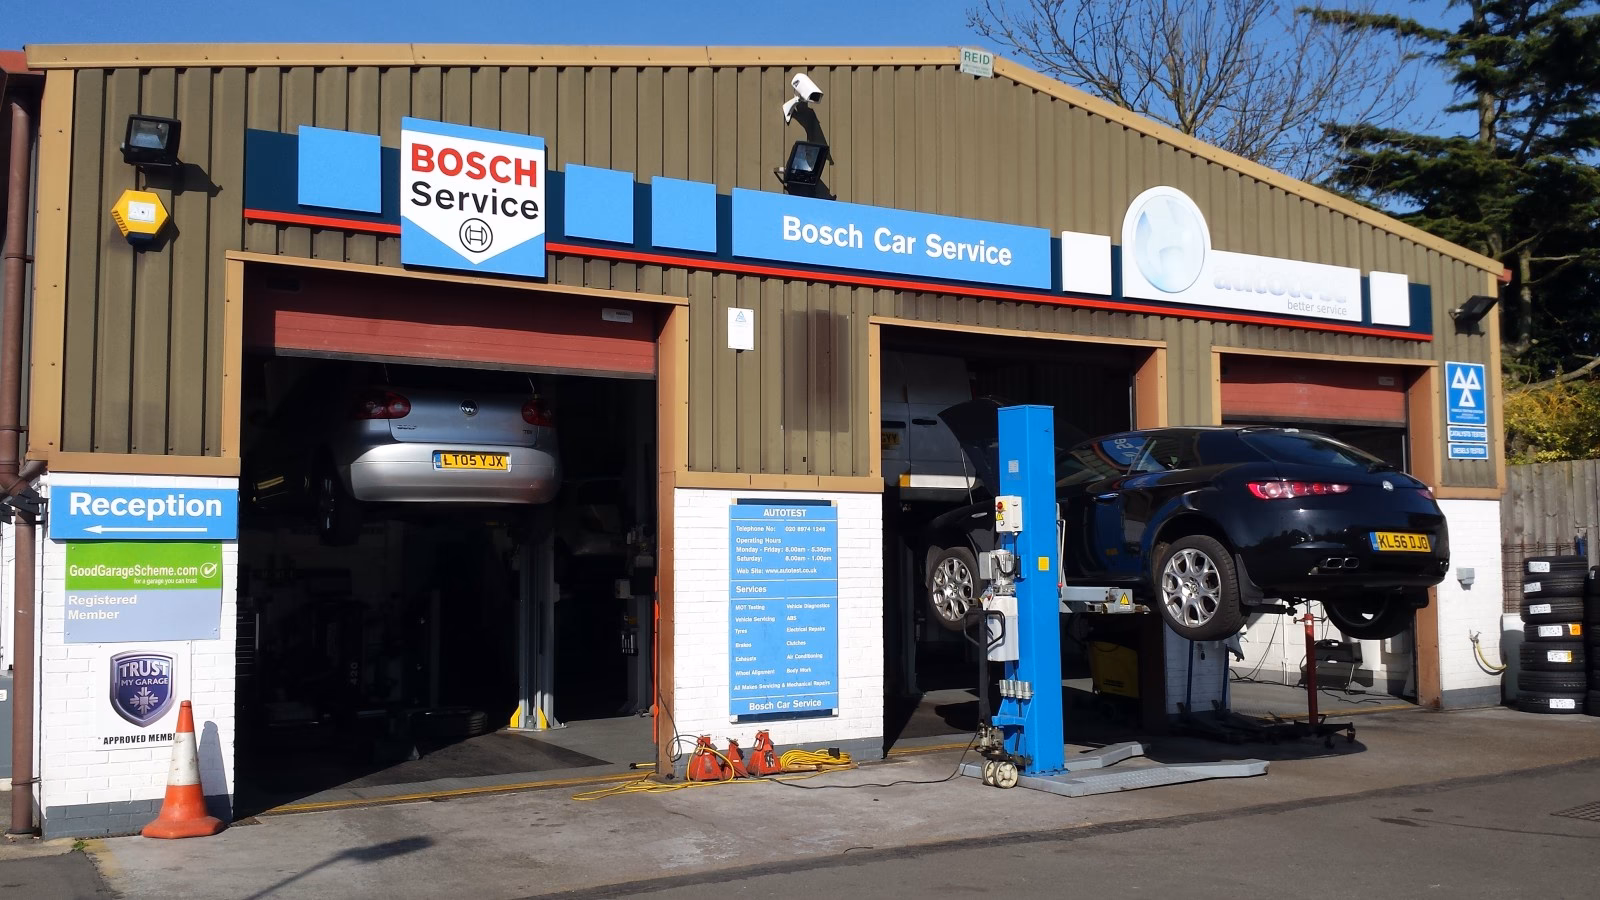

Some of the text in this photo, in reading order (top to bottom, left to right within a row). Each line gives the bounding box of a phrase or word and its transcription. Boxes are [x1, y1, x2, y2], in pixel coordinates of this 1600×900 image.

[964, 51, 990, 65] REID
[411, 142, 537, 188] BOSCH
[411, 180, 539, 220] Service
[783, 215, 1012, 266] Bosch Car Service
[1287, 299, 1347, 316] better service
[443, 454, 503, 467] LT05 YJX
[69, 491, 222, 521] Reception
[763, 508, 807, 517] AUTOTEST
[1378, 534, 1408, 548] KL56
[69, 564, 198, 579] GoodGarageScheme.com
[735, 585, 767, 593] Services
[68, 594, 137, 608] Registered
[68, 609, 120, 620] Member
[119, 660, 169, 678] TRUST
[121, 677, 169, 687] MY GARAGE
[749, 699, 822, 711] Bosch Car Service
[103, 733, 176, 745] APPROVED MEMB
